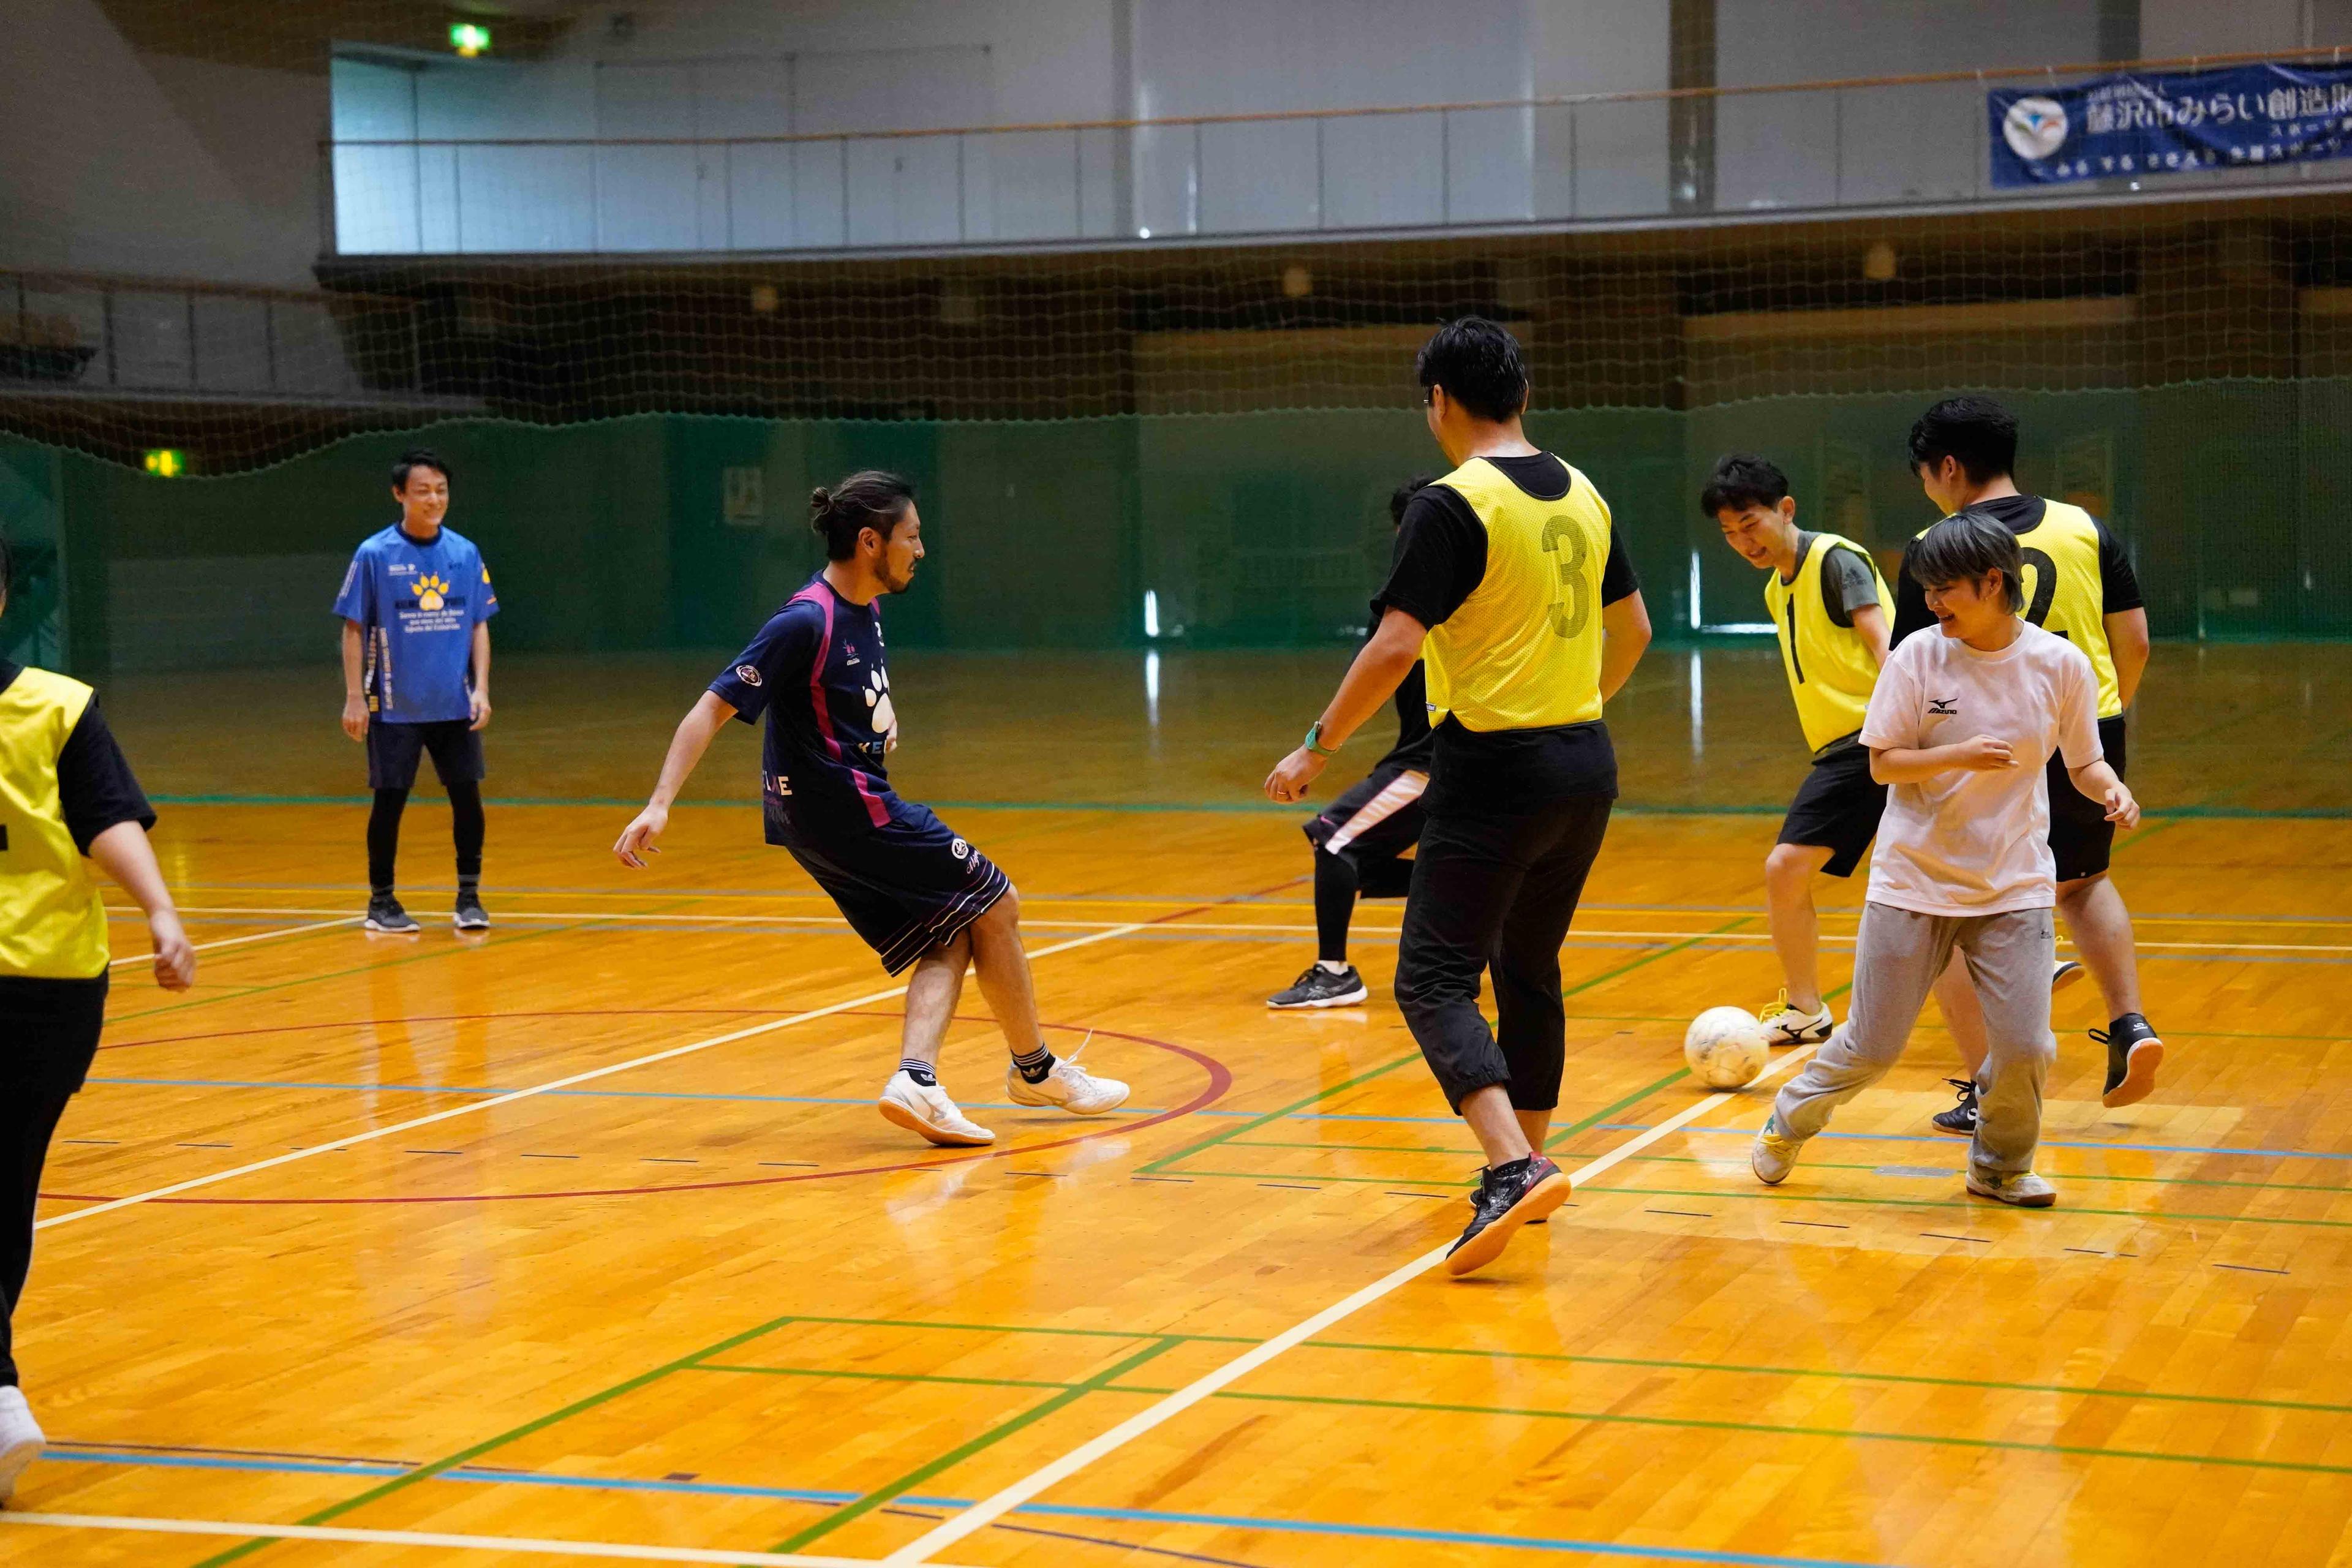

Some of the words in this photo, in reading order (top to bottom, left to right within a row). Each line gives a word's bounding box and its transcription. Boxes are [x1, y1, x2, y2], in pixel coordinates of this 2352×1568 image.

[1542, 514, 1589, 638] 3
[1786, 593, 1806, 685] 1
[858, 739, 887, 755] KE
